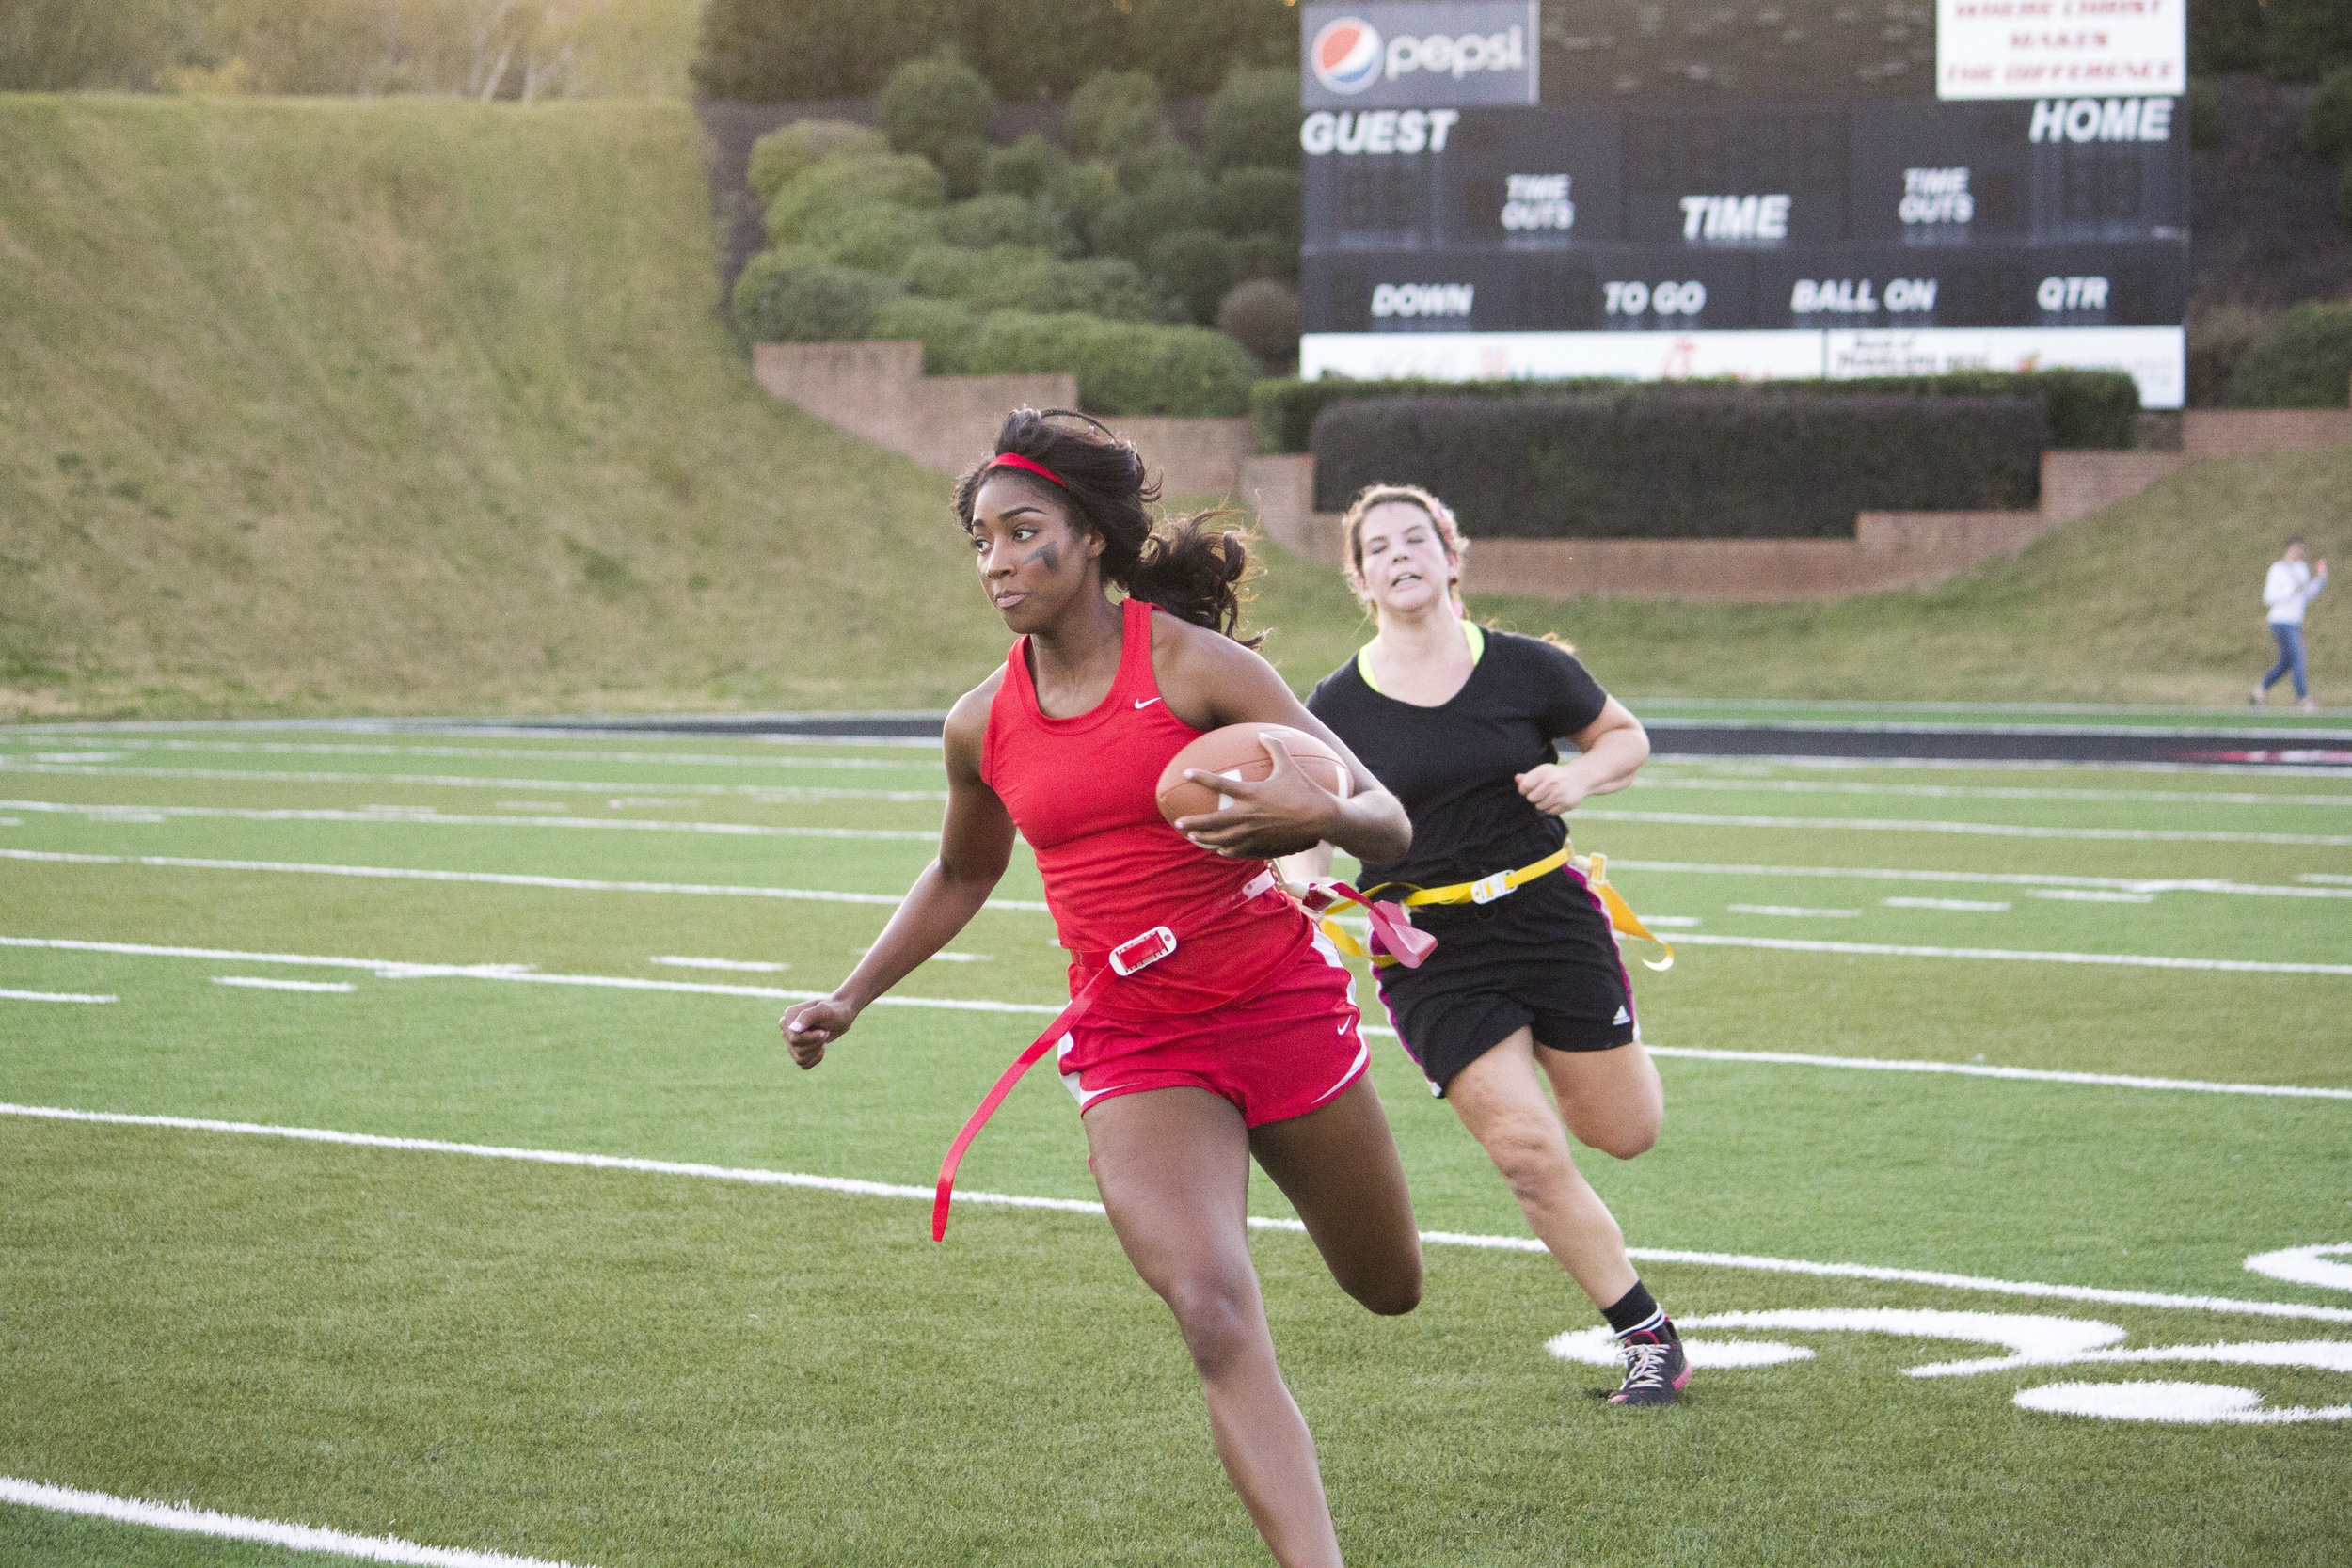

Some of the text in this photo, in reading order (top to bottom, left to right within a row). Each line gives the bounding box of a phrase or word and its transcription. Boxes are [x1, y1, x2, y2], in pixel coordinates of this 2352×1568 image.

[1385, 24, 1524, 80] pepsi
[1300, 109, 1459, 155] GUEST
[2029, 98, 2174, 143] HOME
[1506, 174, 1571, 199] TIME
[1903, 167, 1969, 193] TIME
[1501, 200, 1574, 230] OUTS
[1679, 195, 1791, 242] TIME
[1899, 194, 1974, 223] OUTS
[1371, 283, 1474, 317] DOWN
[1604, 280, 1707, 316] TO GO
[1790, 278, 1938, 314] BALL ON
[2036, 276, 2109, 311] QTR
